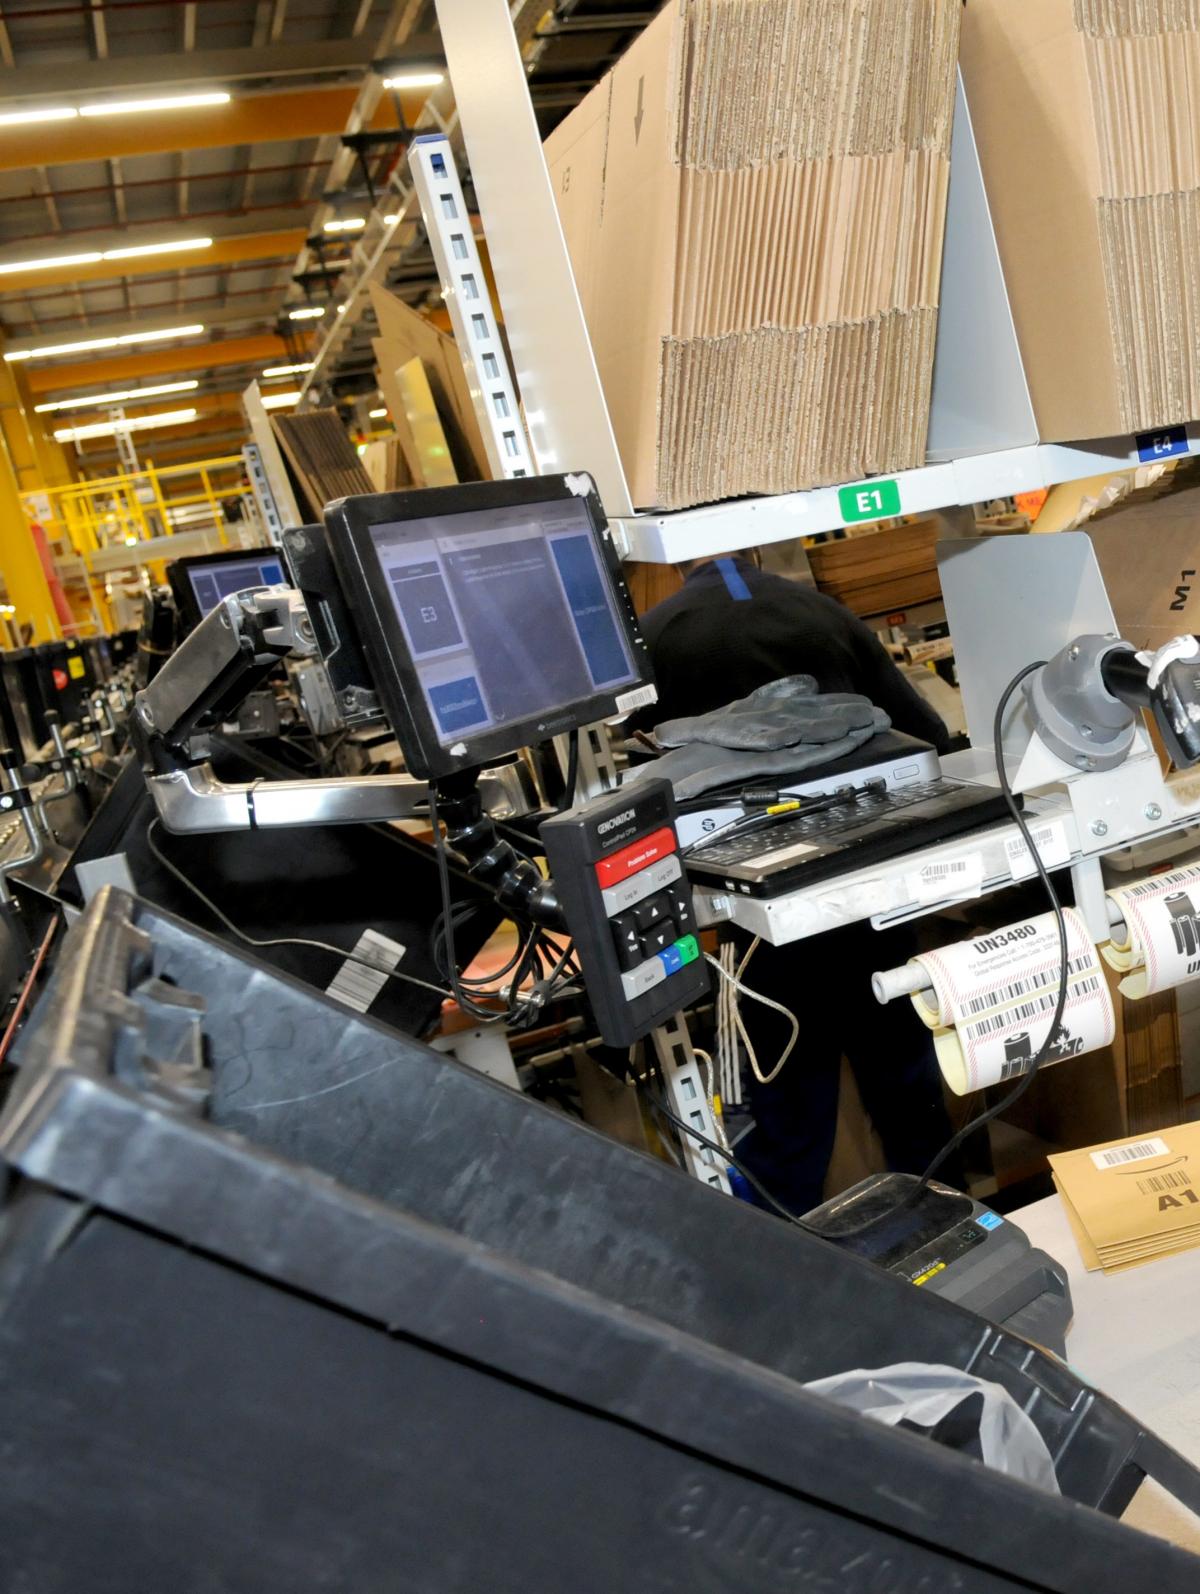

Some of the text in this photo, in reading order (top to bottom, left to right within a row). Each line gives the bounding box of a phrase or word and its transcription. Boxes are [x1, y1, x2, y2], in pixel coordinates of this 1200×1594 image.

[1153, 436, 1172, 454] E4
[855, 489, 883, 513] E1
[1169, 570, 1196, 611] M1
[420, 606, 438, 624] E3
[597, 808, 637, 835] GENOVATION
[973, 924, 1037, 954] UN3480
[1158, 1189, 1199, 1212] A1
